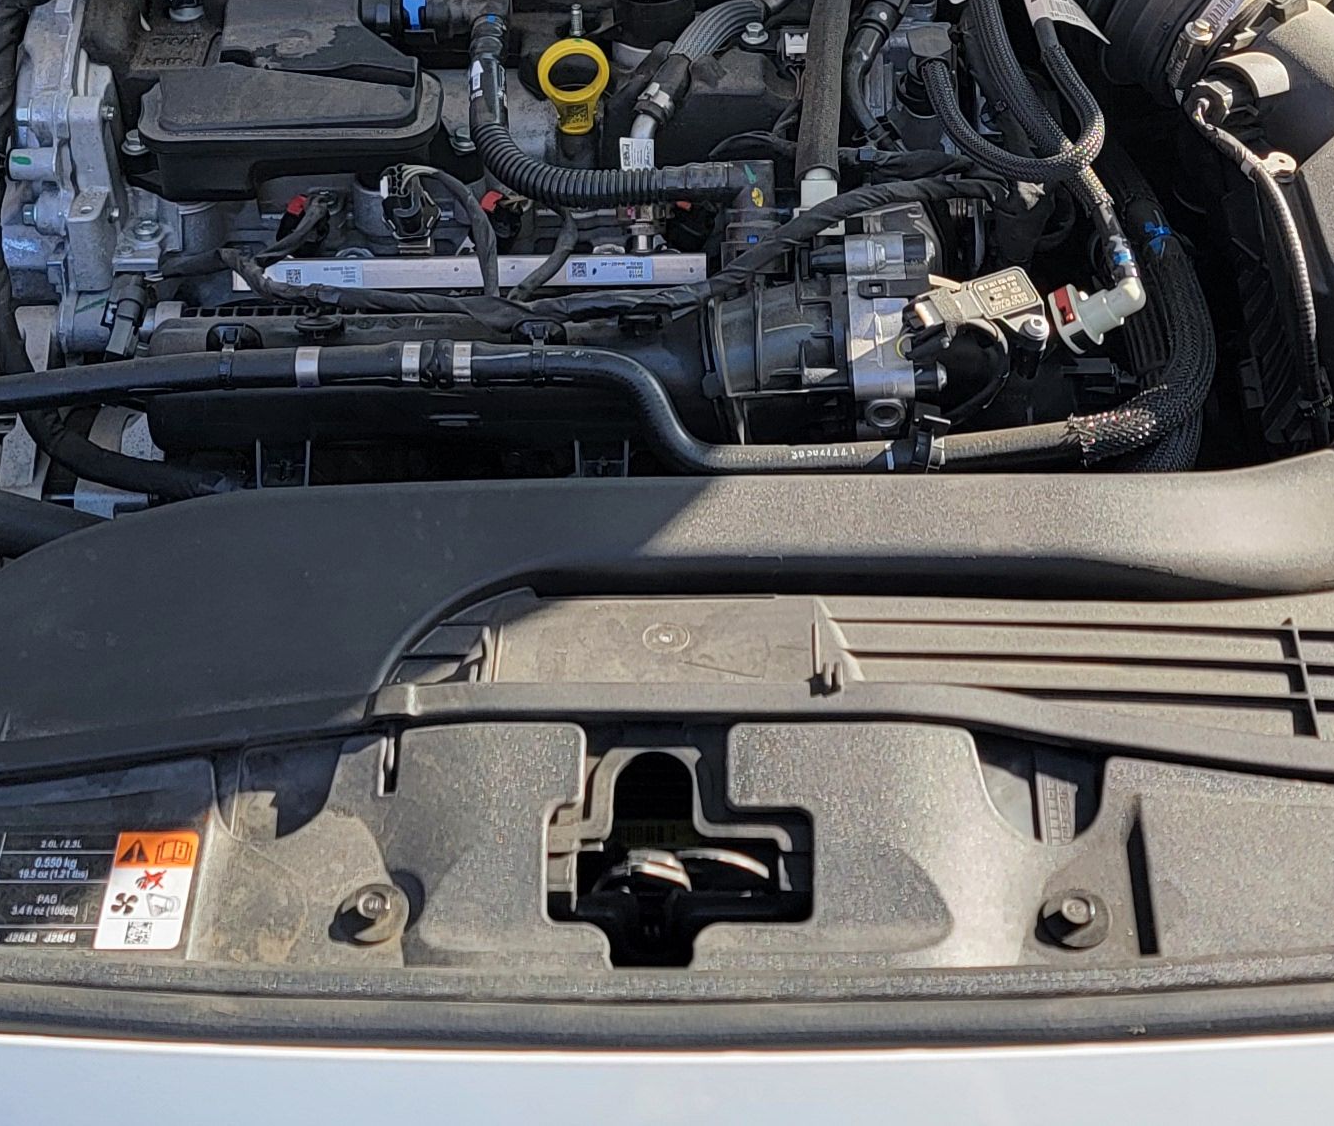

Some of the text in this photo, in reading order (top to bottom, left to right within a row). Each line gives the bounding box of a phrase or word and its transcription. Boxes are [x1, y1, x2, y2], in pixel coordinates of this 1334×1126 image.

[34, 857, 78, 870] 0.550 kg
[36, 894, 58, 904] PAG
